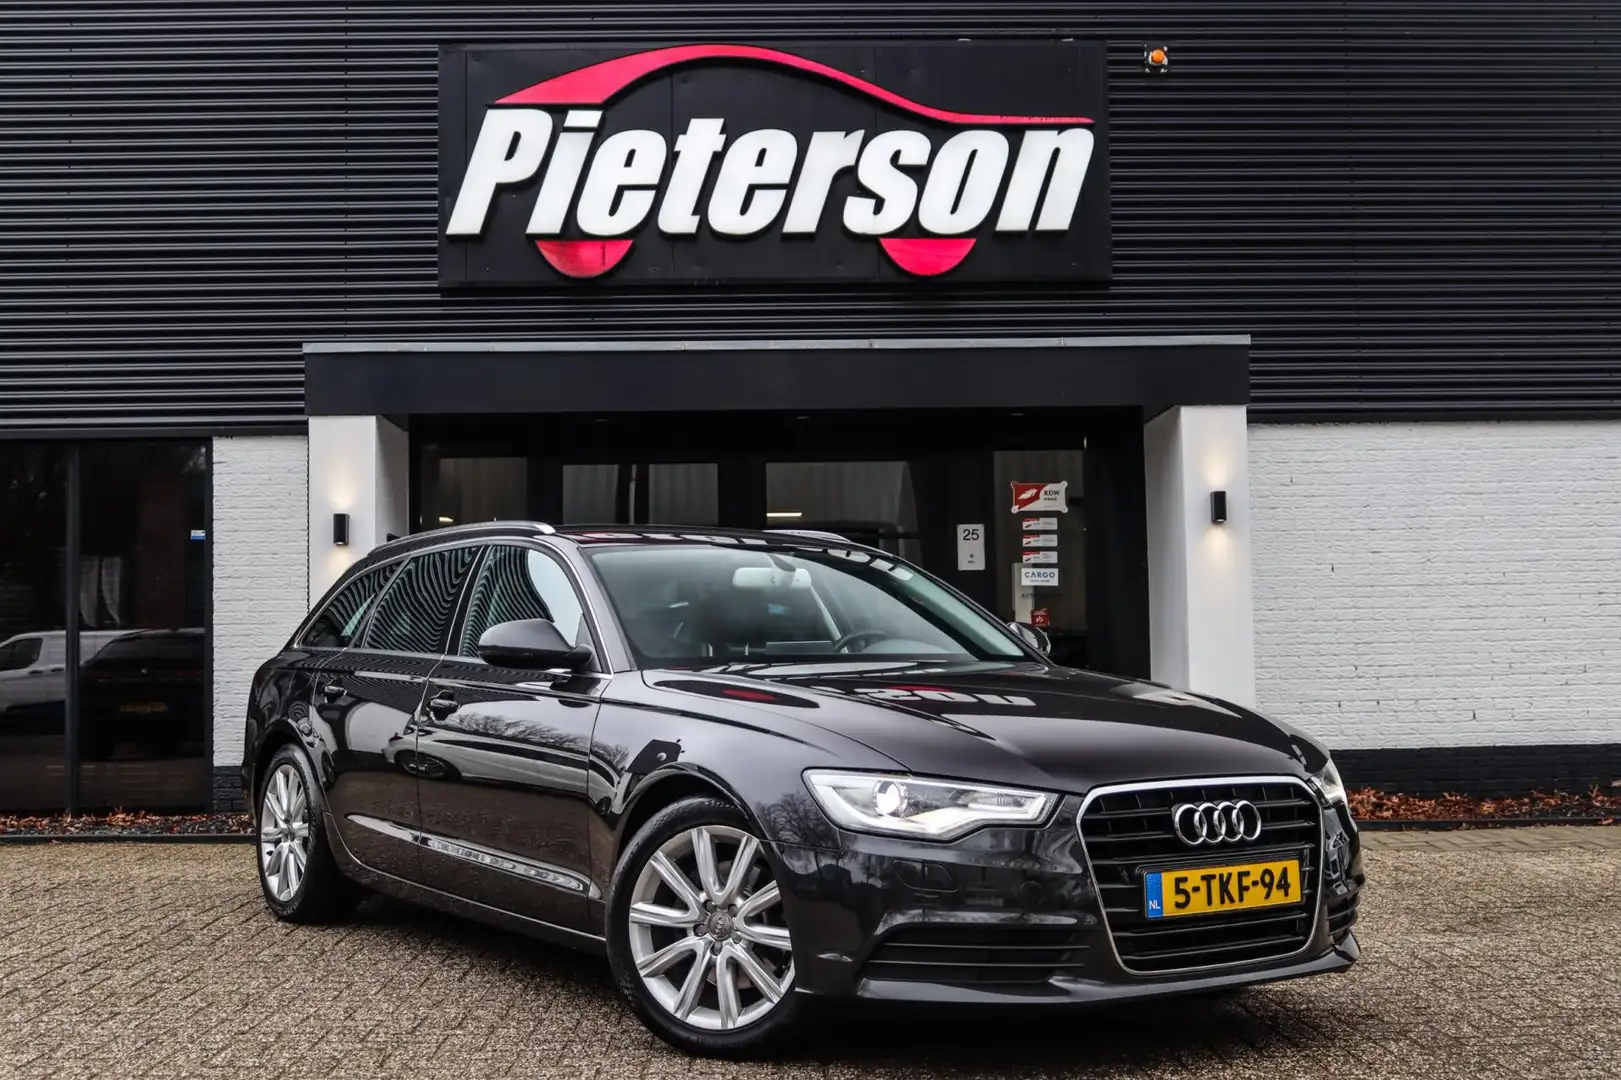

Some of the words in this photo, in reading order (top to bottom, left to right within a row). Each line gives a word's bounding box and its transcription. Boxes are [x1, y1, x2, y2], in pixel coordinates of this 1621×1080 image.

[445, 108, 1095, 237] Pieterson
[963, 529, 979, 541] 25
[1024, 571, 1055, 579] CARGO
[1149, 900, 1161, 910] NL
[1174, 866, 1291, 909] 5-TKF-94
